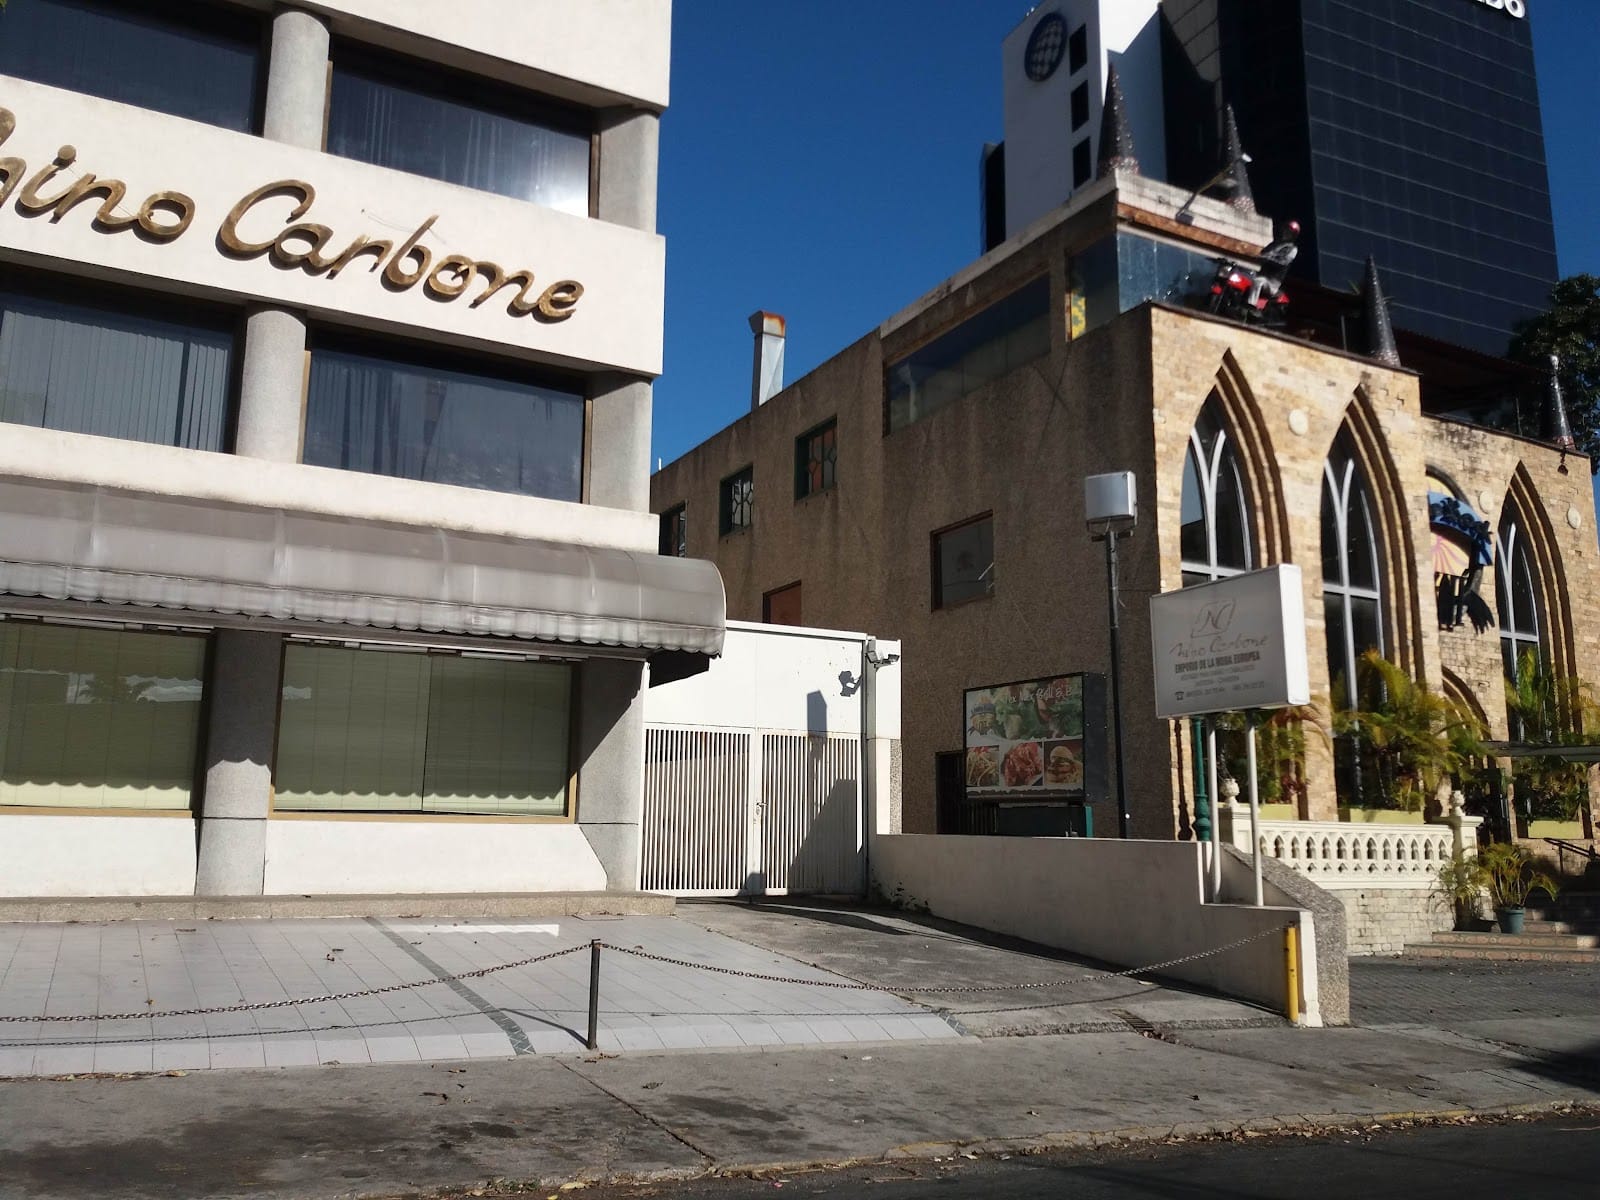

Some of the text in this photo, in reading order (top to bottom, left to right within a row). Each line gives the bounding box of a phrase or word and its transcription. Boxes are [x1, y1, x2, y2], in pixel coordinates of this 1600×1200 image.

[216, 179, 584, 320] Carbone
[1199, 659, 1206, 670] DE
[1207, 657, 1215, 667] LA
